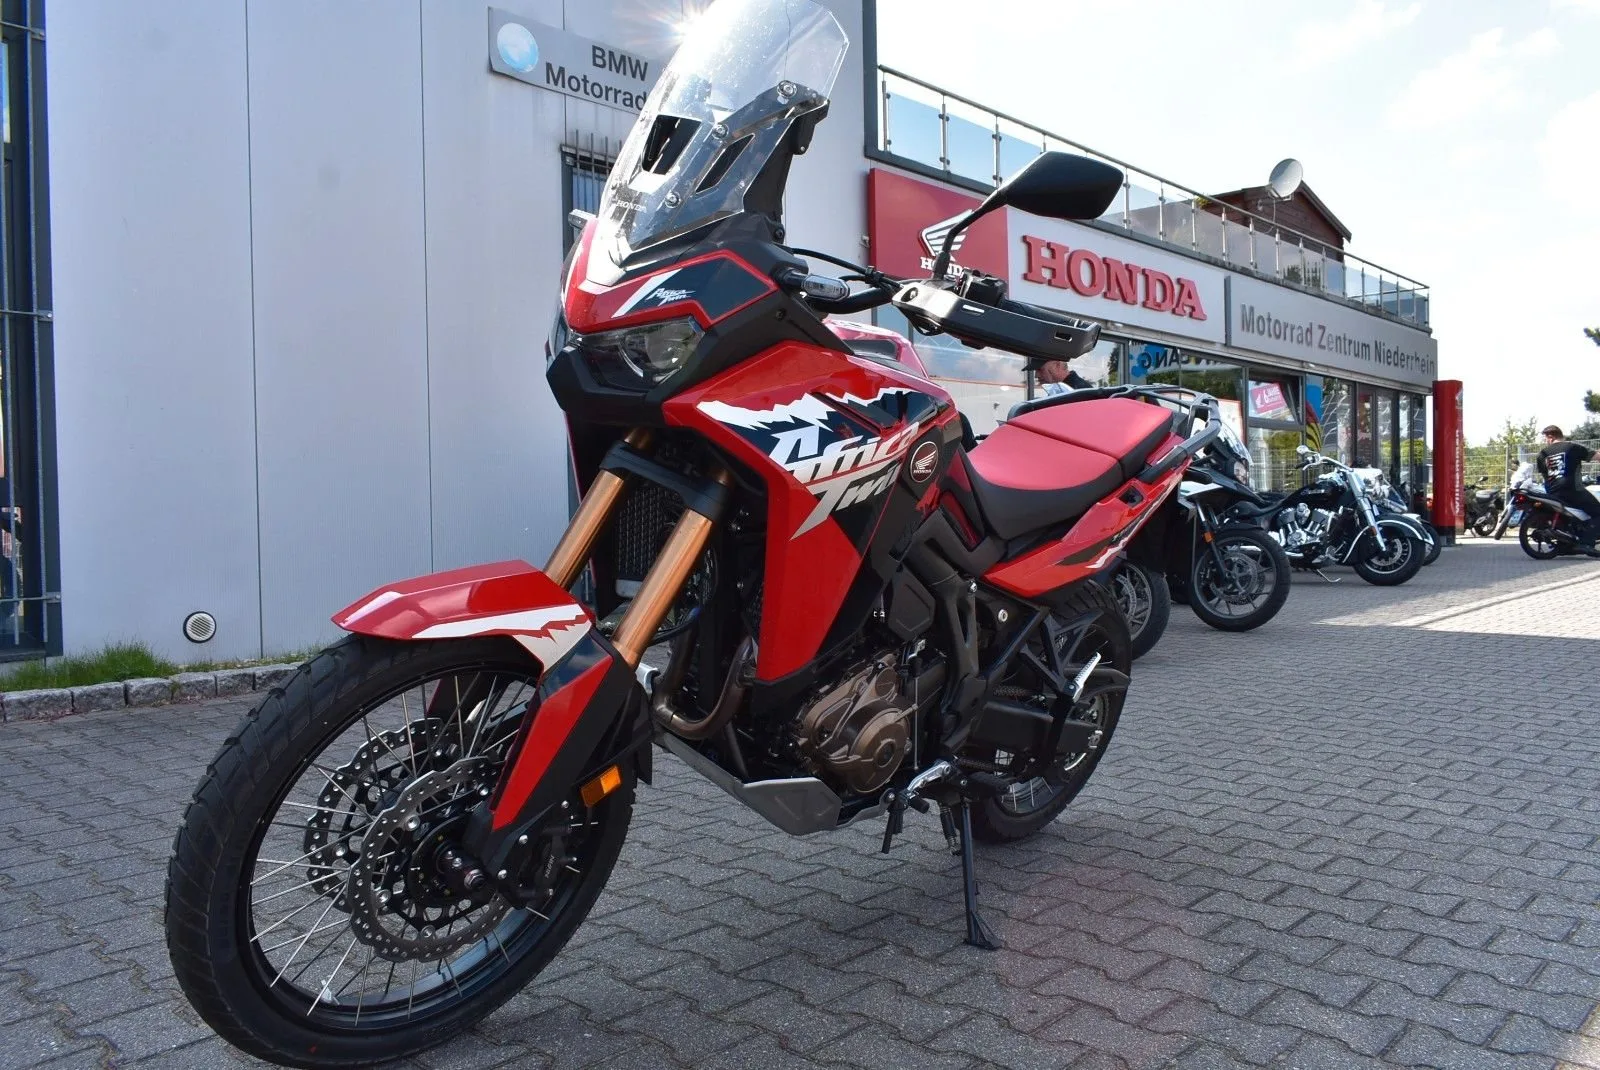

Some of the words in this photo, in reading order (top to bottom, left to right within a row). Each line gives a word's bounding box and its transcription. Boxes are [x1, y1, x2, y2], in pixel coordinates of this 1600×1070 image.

[546, 62, 648, 112] Motorrad
[592, 45, 648, 81] BMW
[616, 200, 647, 213] HONDA
[1022, 235, 1207, 320] HONDA
[1240, 304, 1313, 347] Motorrad
[1318, 325, 1371, 361] Zentrum
[1374, 340, 1435, 376] Niederrhein
